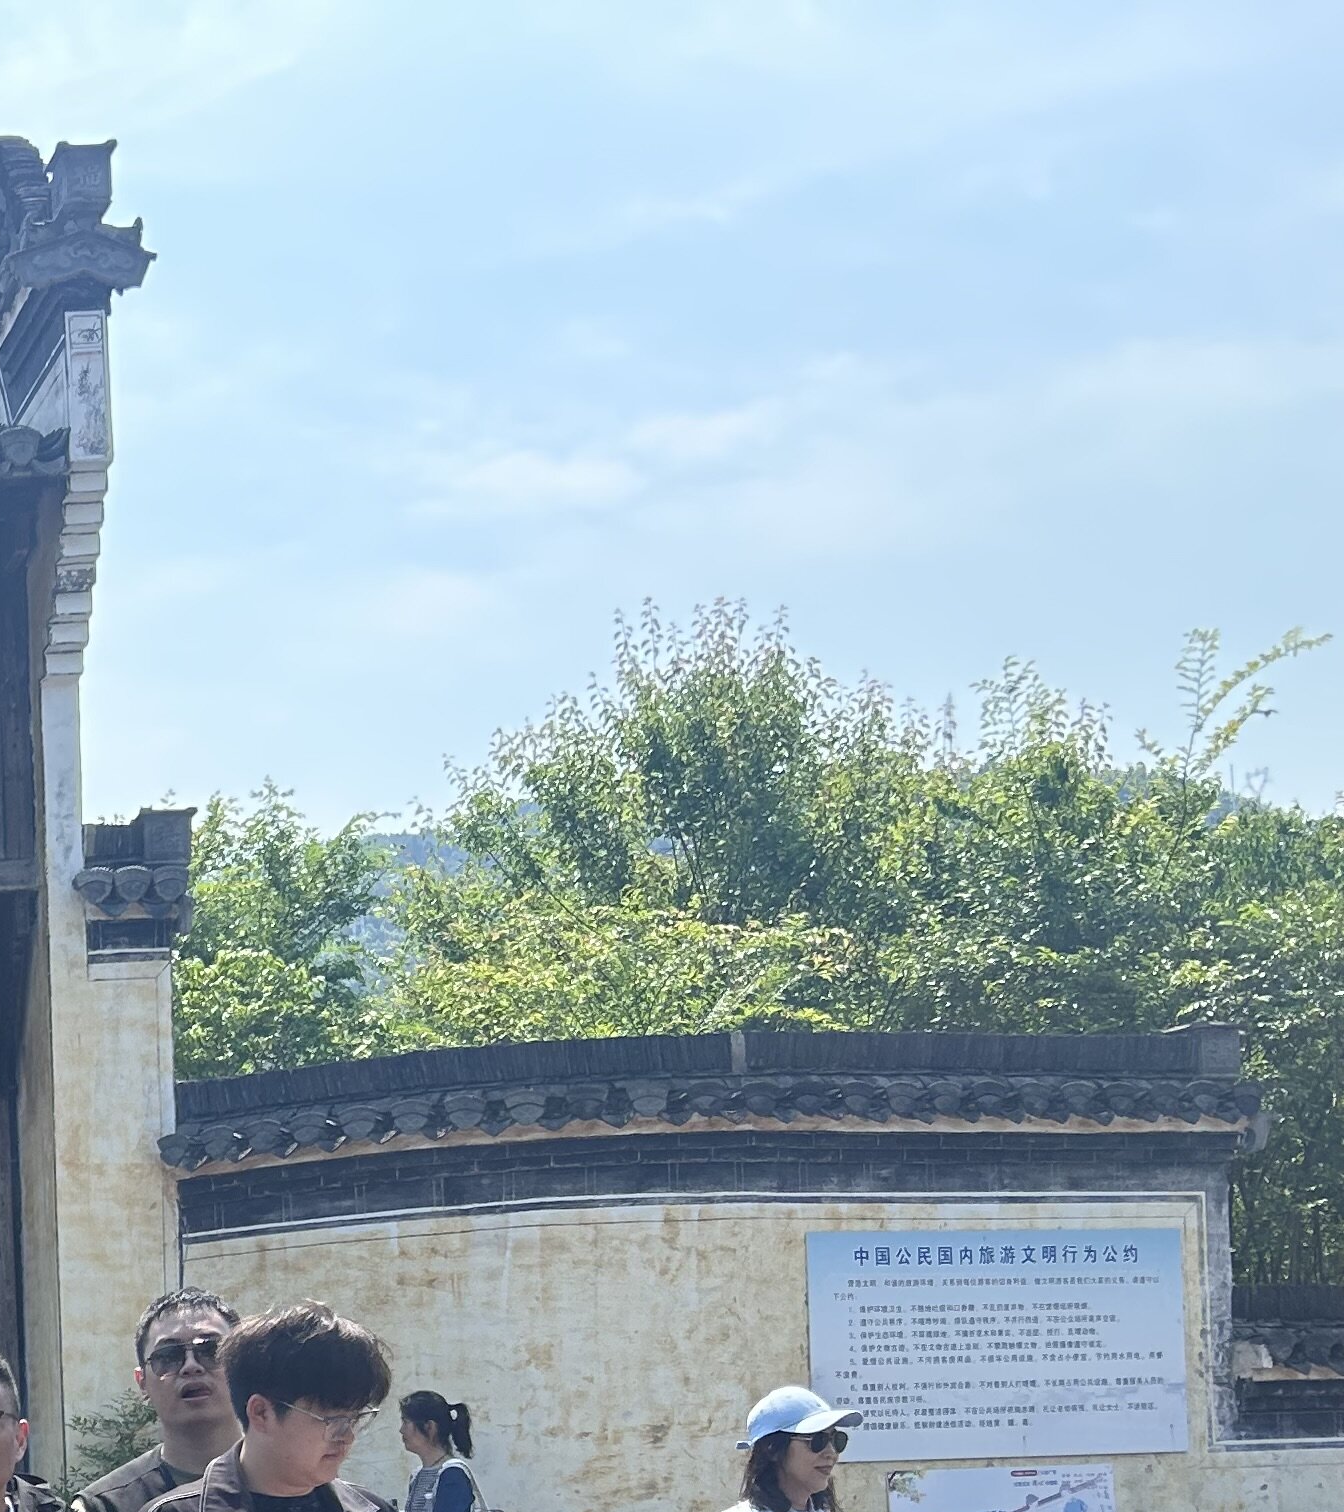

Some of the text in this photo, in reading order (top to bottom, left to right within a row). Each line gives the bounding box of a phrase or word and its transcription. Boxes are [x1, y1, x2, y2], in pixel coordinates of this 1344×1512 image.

[854, 1244, 1139, 1267] 中国公民国内旅游文明行为公约
